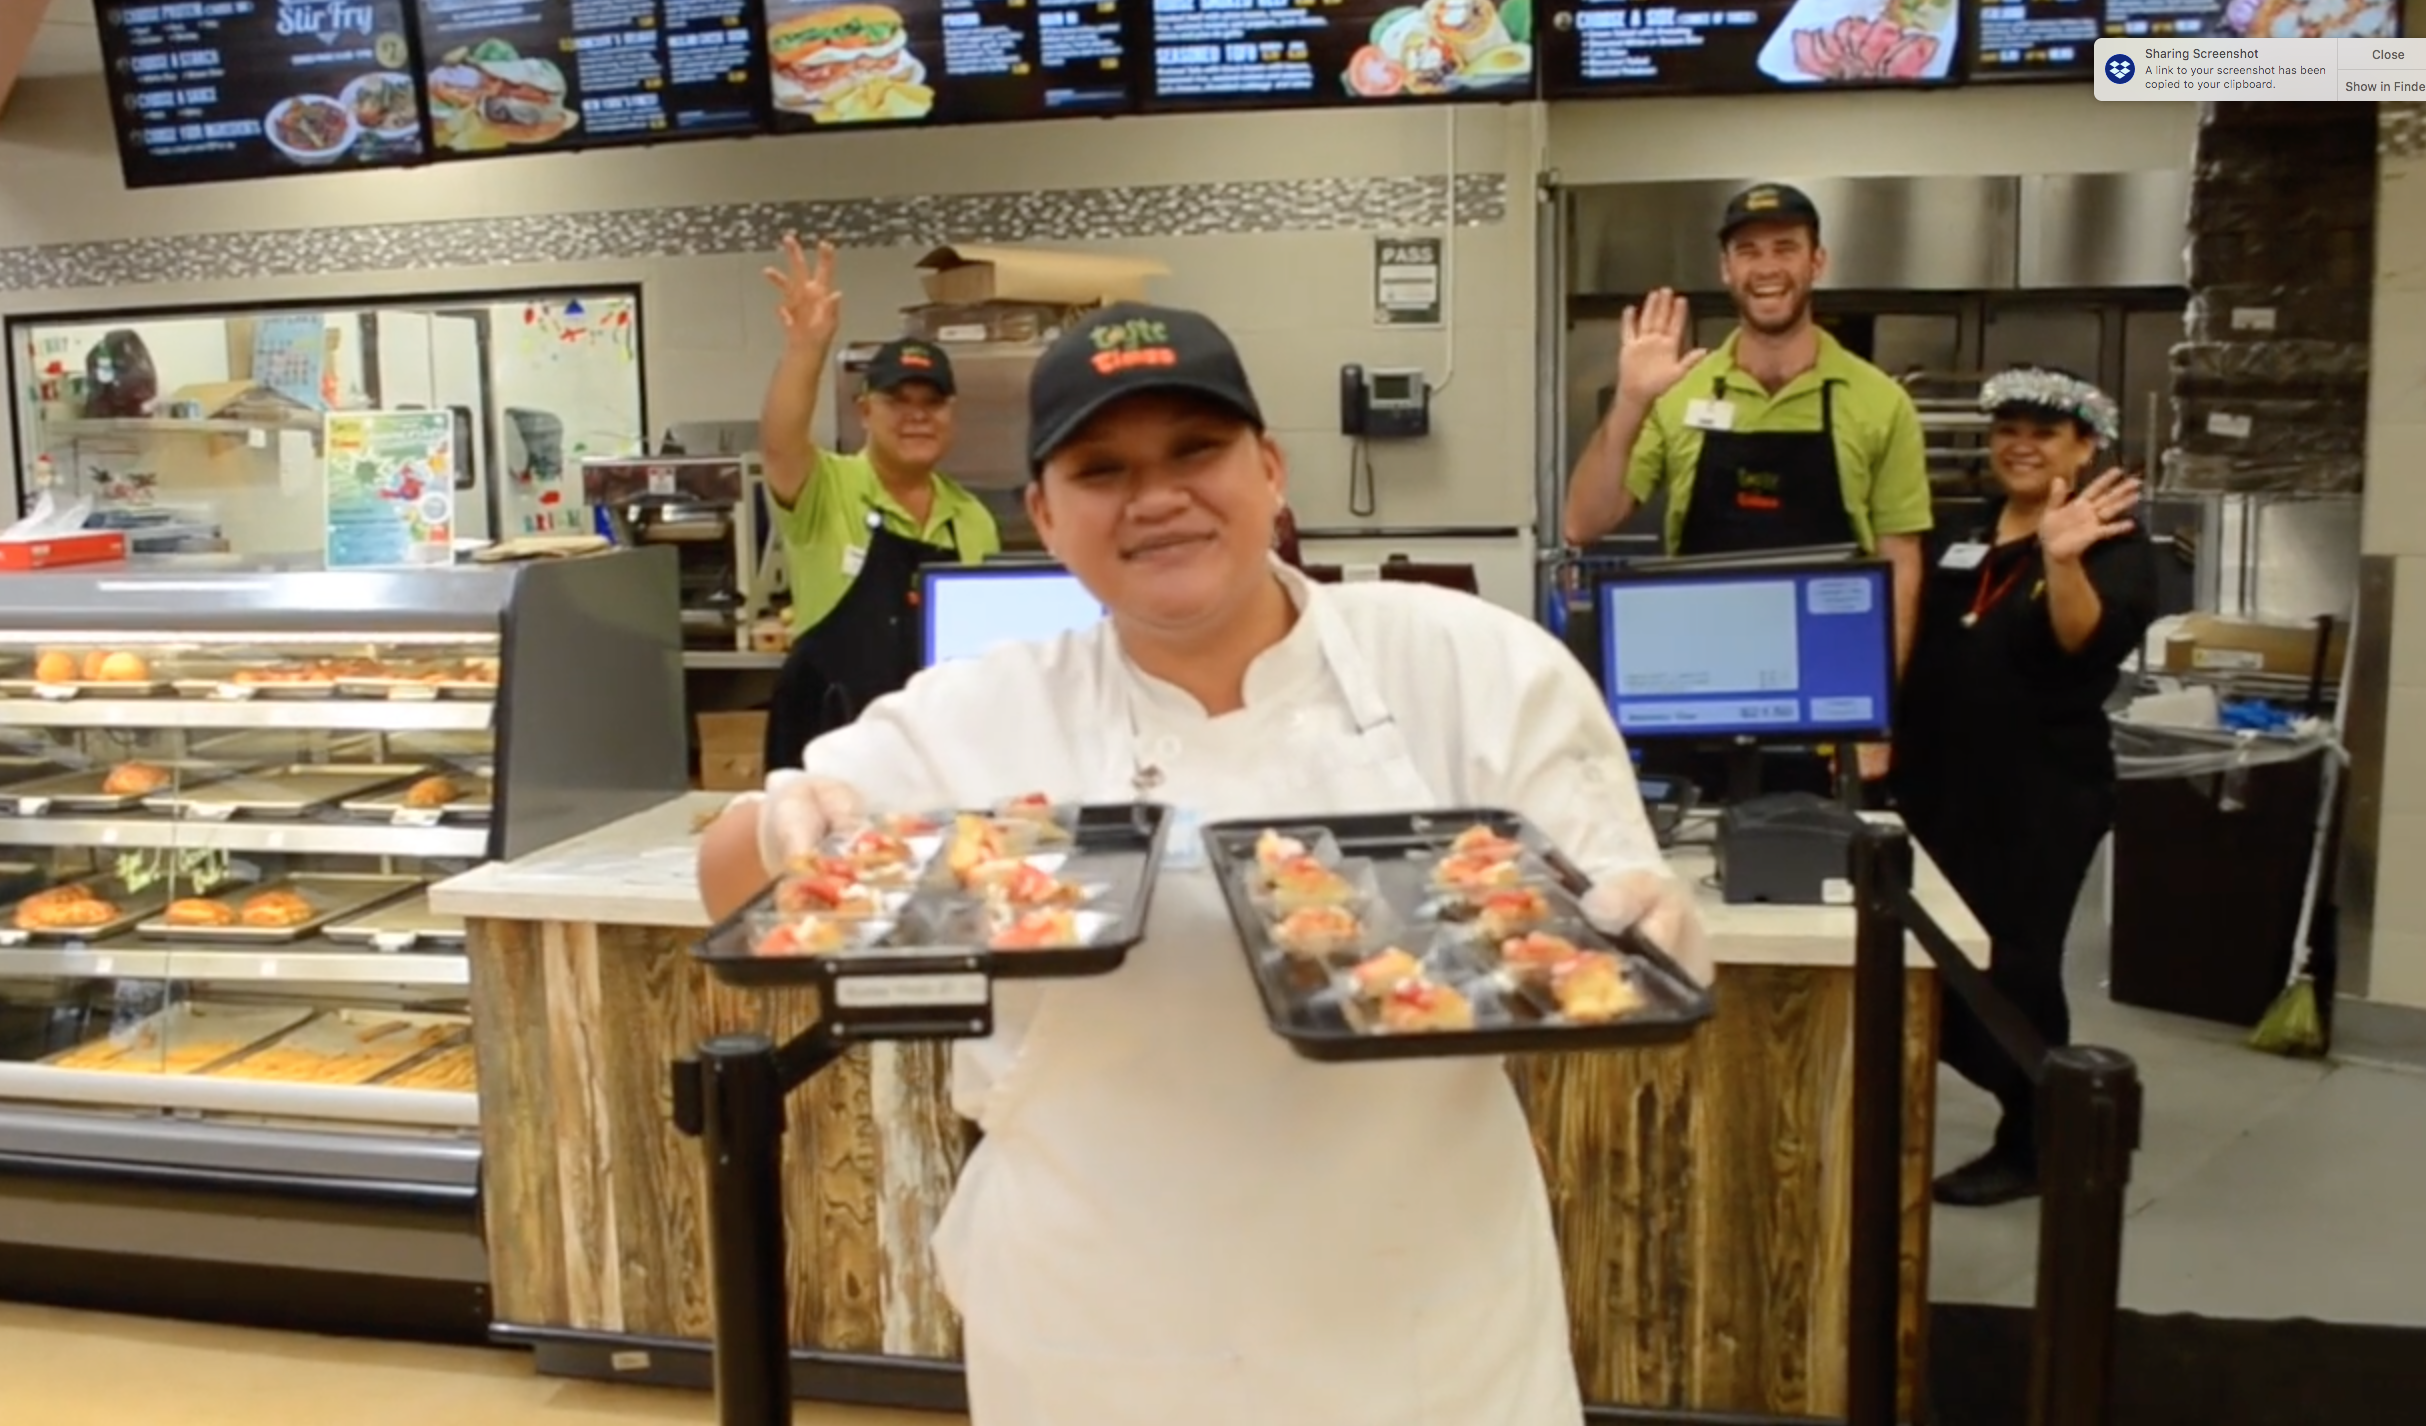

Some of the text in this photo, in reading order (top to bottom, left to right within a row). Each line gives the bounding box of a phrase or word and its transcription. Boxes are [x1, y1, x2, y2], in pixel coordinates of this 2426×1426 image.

[276, 0, 373, 36] Stir Fry
[1382, 245, 1434, 263] PASS
